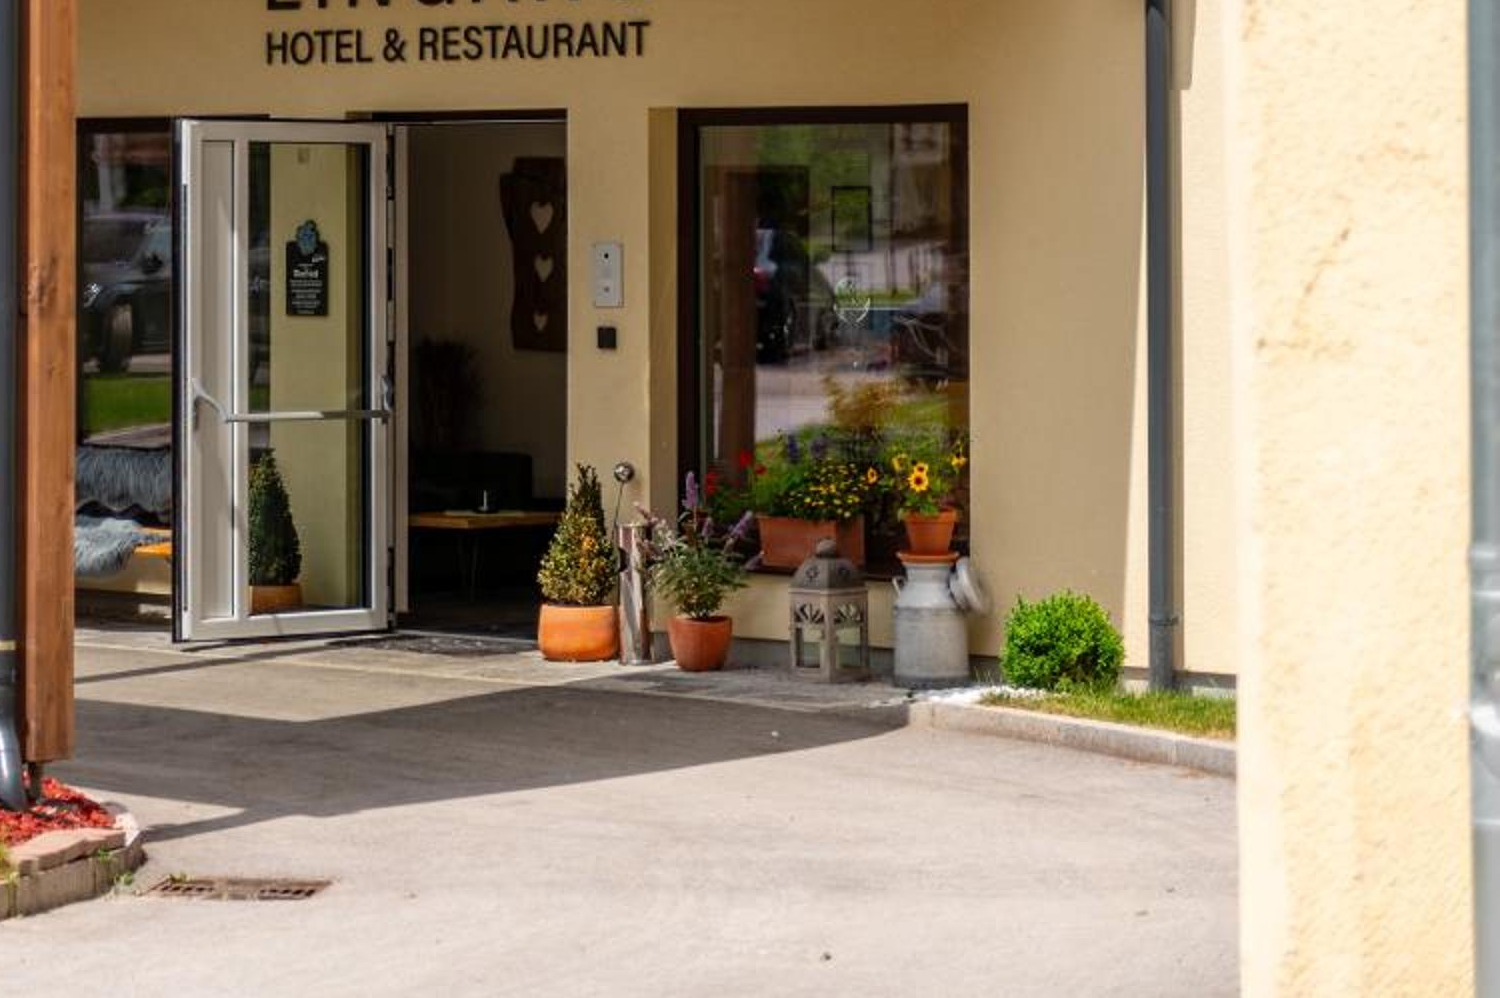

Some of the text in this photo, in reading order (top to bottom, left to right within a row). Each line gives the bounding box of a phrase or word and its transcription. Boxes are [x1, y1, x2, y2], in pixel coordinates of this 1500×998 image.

[266, 20, 651, 65] HOTEL & RESTAURANT
